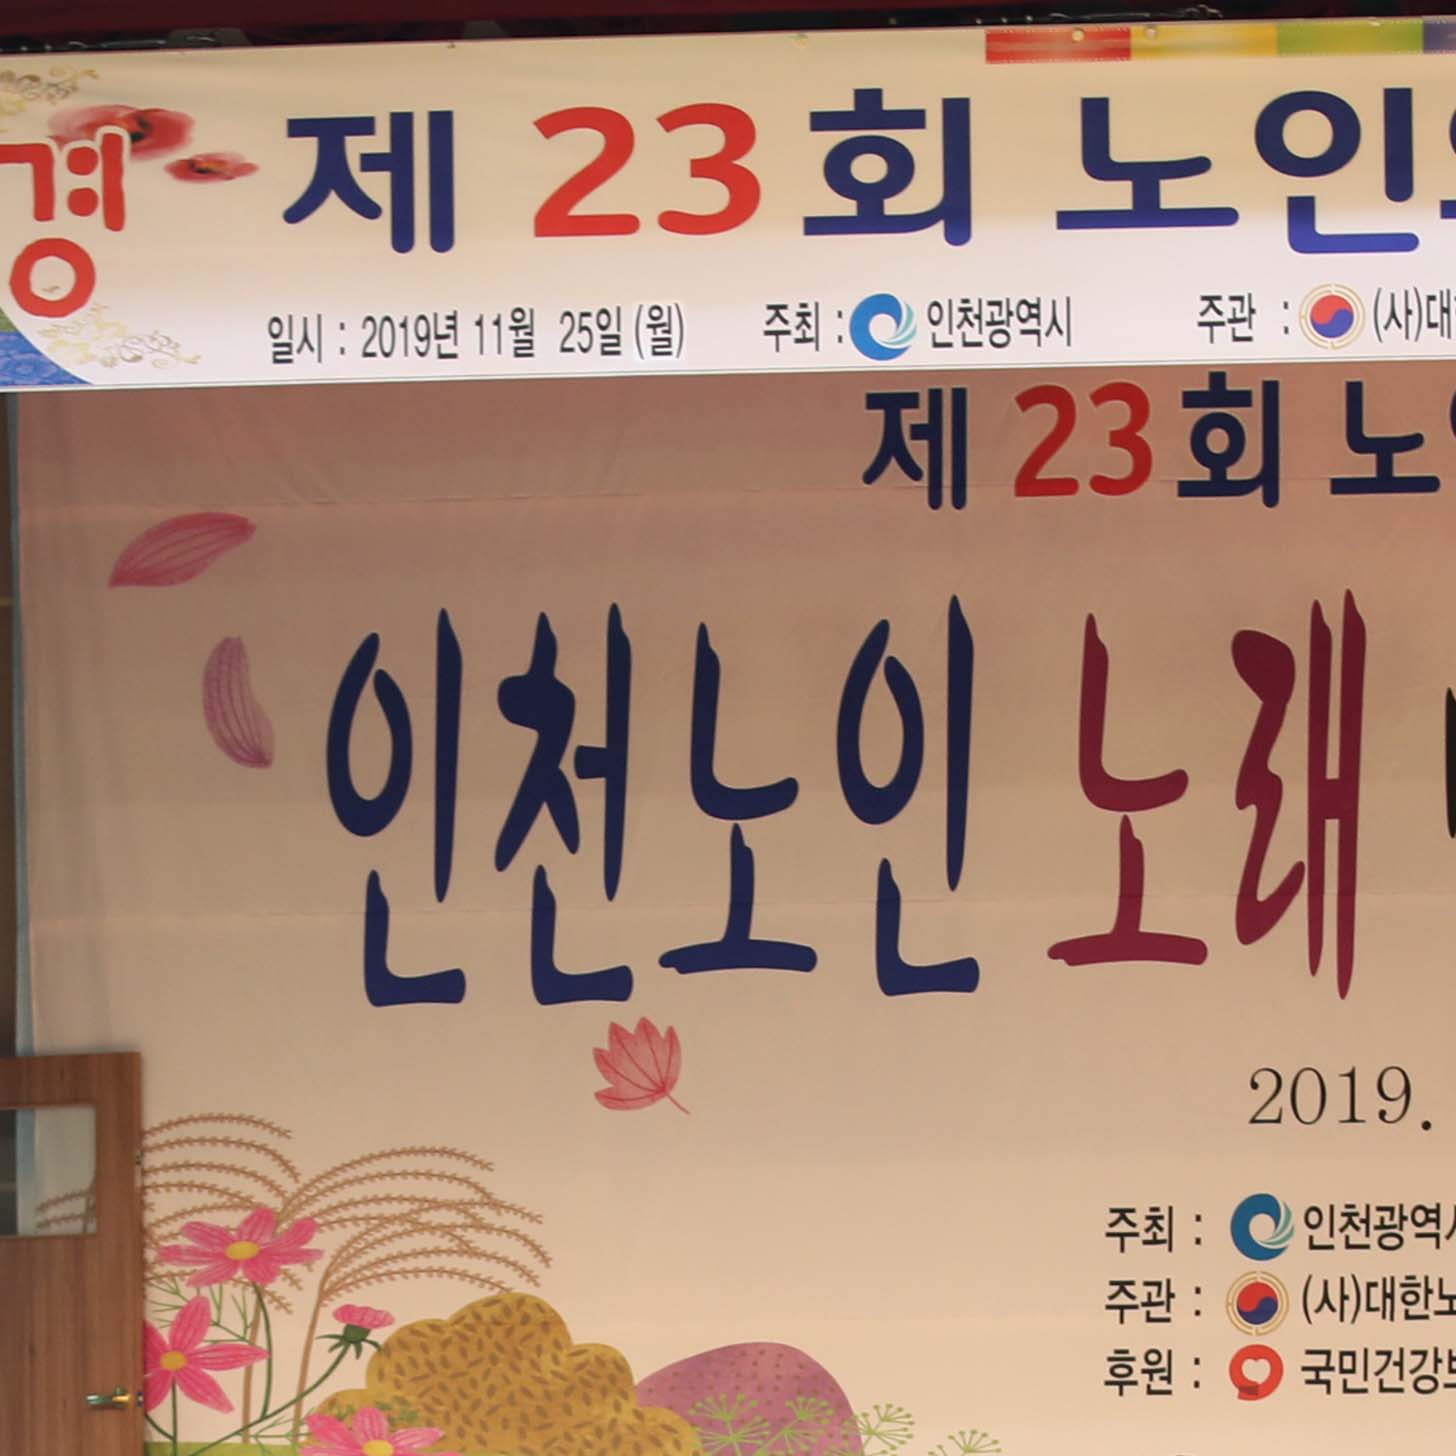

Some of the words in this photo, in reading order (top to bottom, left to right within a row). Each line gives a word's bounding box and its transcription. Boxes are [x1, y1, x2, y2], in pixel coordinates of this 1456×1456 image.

[282, 110, 455, 254] 제
[268, 314, 322, 365] 일시
[362, 310, 459, 360] 2019년
[474, 307, 535, 358] 11월
[559, 306, 622, 356] 25일
[635, 303, 684, 357] (월)
[763, 301, 819, 353] 주최
[927, 296, 1071, 349] 인천광역시
[1197, 293, 1257, 344] 주관
[862, 387, 967, 511] 제
[325, 594, 980, 1008] 인천노인
[1047, 588, 1367, 1000] 노래
[1249, 1066, 1432, 1131] 2019.
[1105, 1205, 1175, 1254] 주최
[1105, 1278, 1176, 1325] 주관
[1104, 1348, 1174, 1397] 후원
